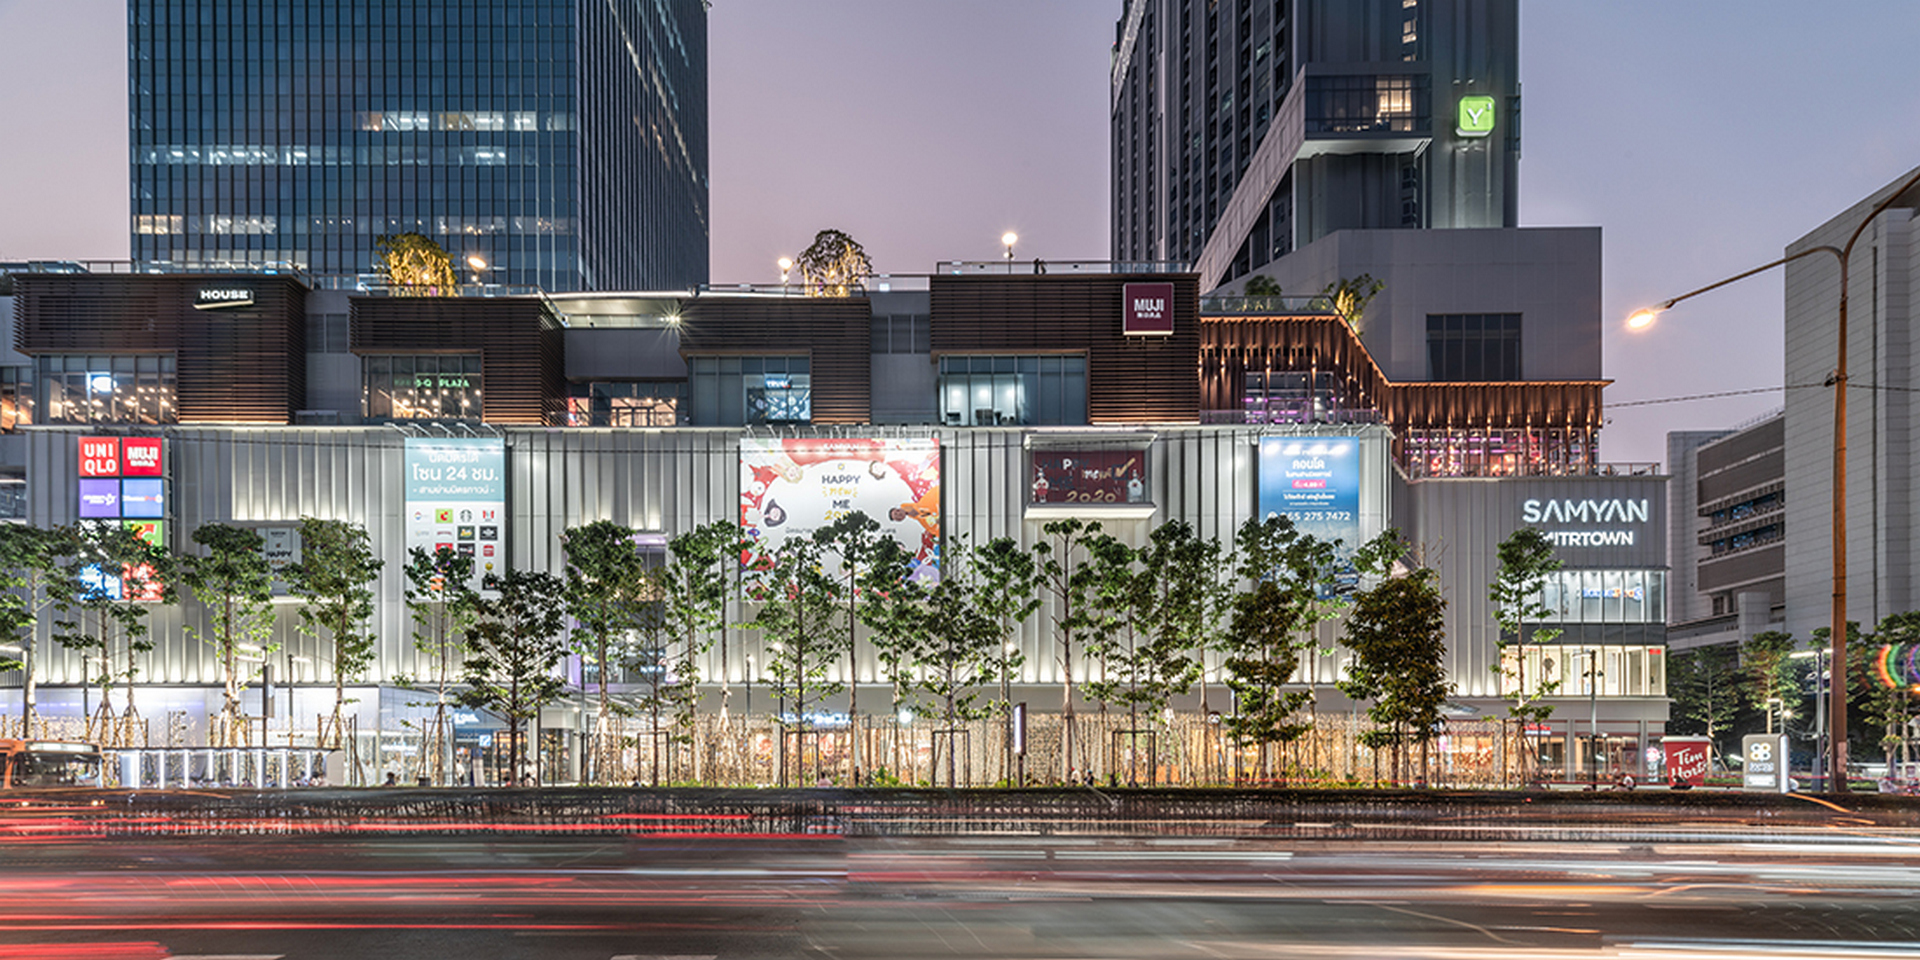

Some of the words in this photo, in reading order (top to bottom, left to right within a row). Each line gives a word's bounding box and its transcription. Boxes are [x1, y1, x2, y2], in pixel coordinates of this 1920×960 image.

[201, 289, 248, 300] HOUSE
[1134, 298, 1164, 311] MUJI
[84, 443, 113, 458] UNI
[128, 446, 159, 460] MUJI
[84, 459, 117, 475] QLO
[412, 463, 441, 481] โซน
[446, 466, 467, 481] 24
[471, 467, 499, 481] ชม.
[822, 474, 860, 484] HAPPY
[1066, 489, 1116, 503] 2020
[832, 500, 850, 508] ME
[1522, 499, 1648, 522] SAMYAN
[1304, 511, 1323, 521] 275
[1325, 511, 1351, 521] 7472
[1673, 747, 1703, 765] Tim
